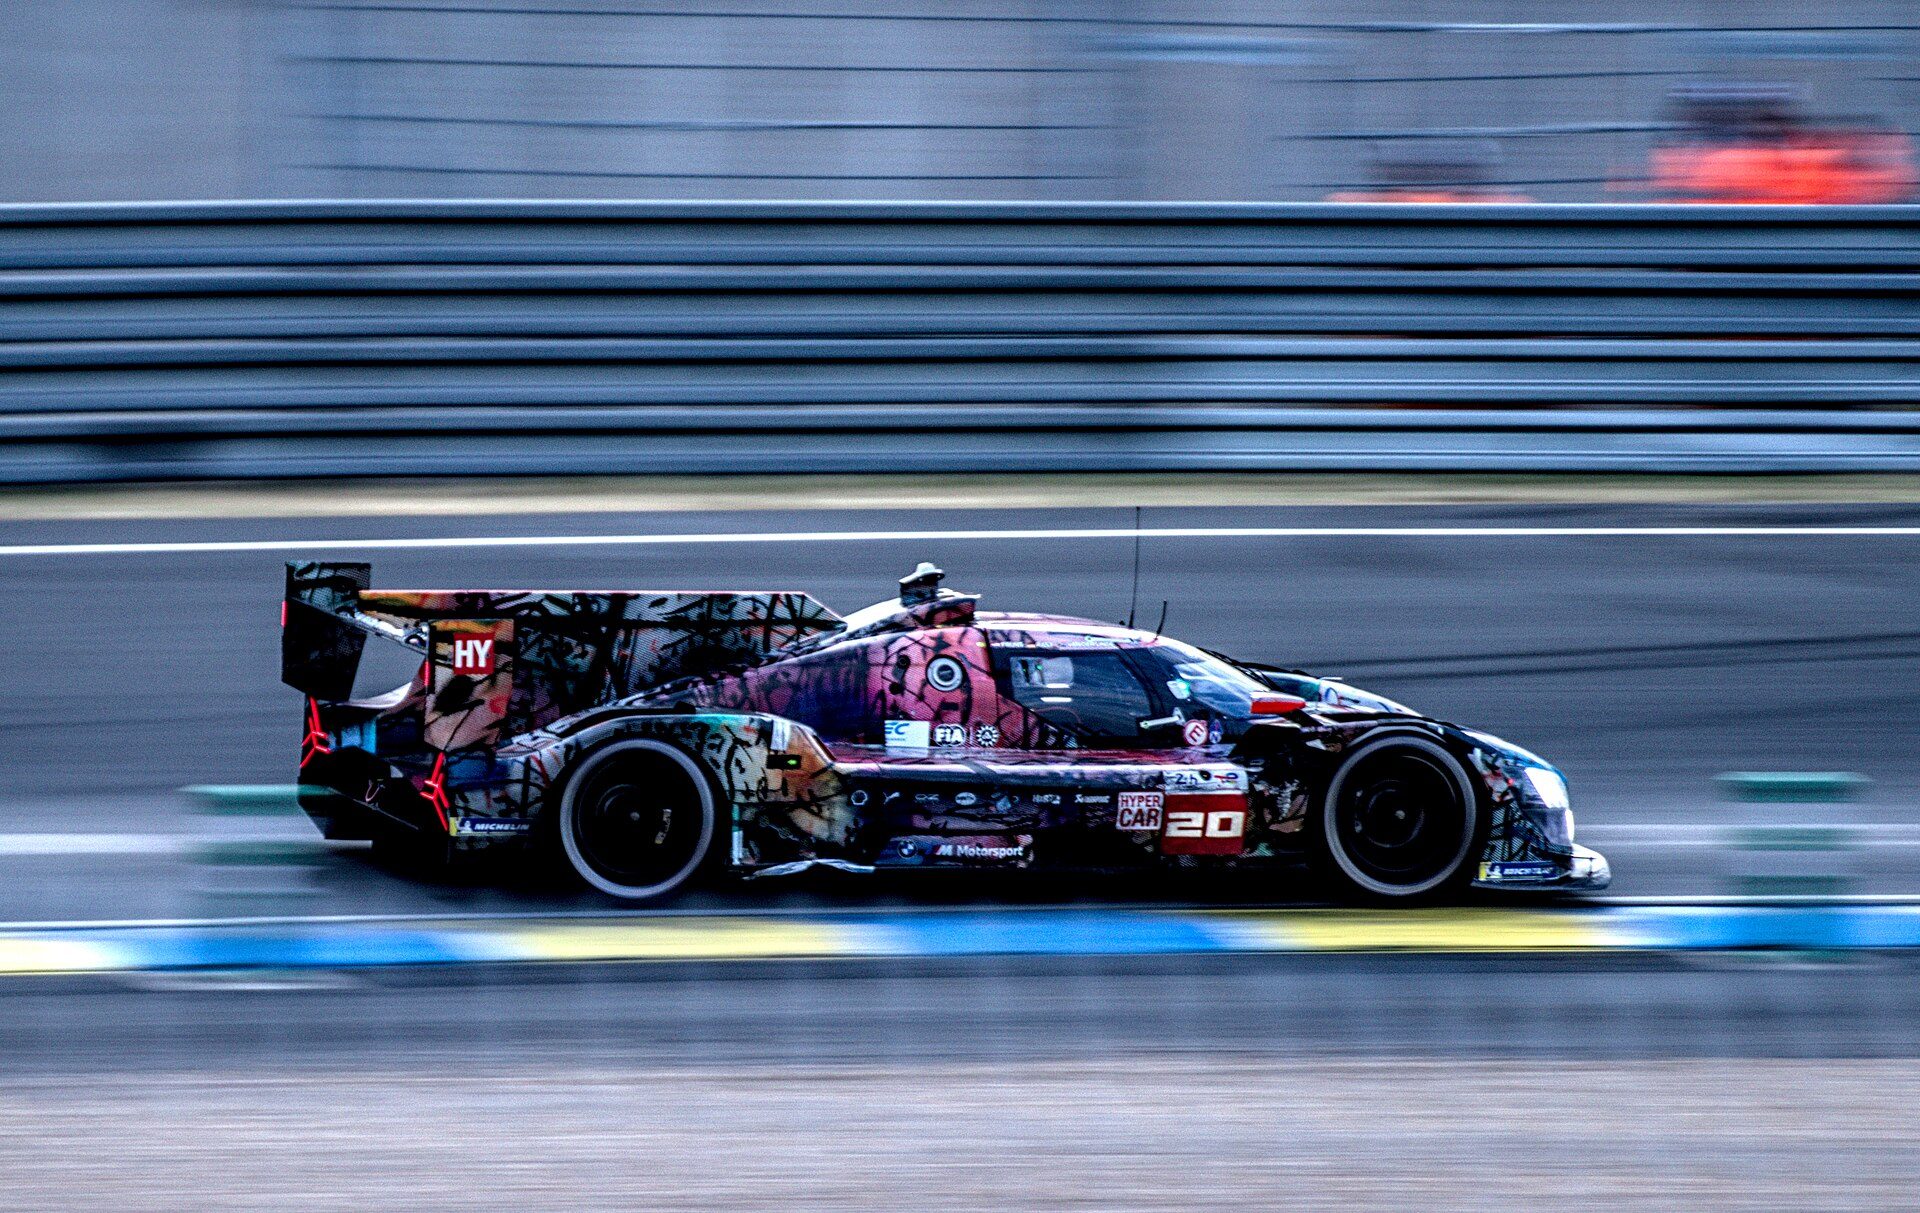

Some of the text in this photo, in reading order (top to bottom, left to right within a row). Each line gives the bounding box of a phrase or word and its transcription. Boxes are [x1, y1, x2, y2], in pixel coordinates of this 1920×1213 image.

[455, 639, 493, 668] HY
[936, 728, 964, 742] FIA
[1120, 795, 1160, 807] HYPER
[1120, 808, 1160, 827] CAR
[1165, 811, 1244, 837] 20
[474, 823, 530, 831] MICHELIN
[956, 844, 1024, 859] Motorsport
